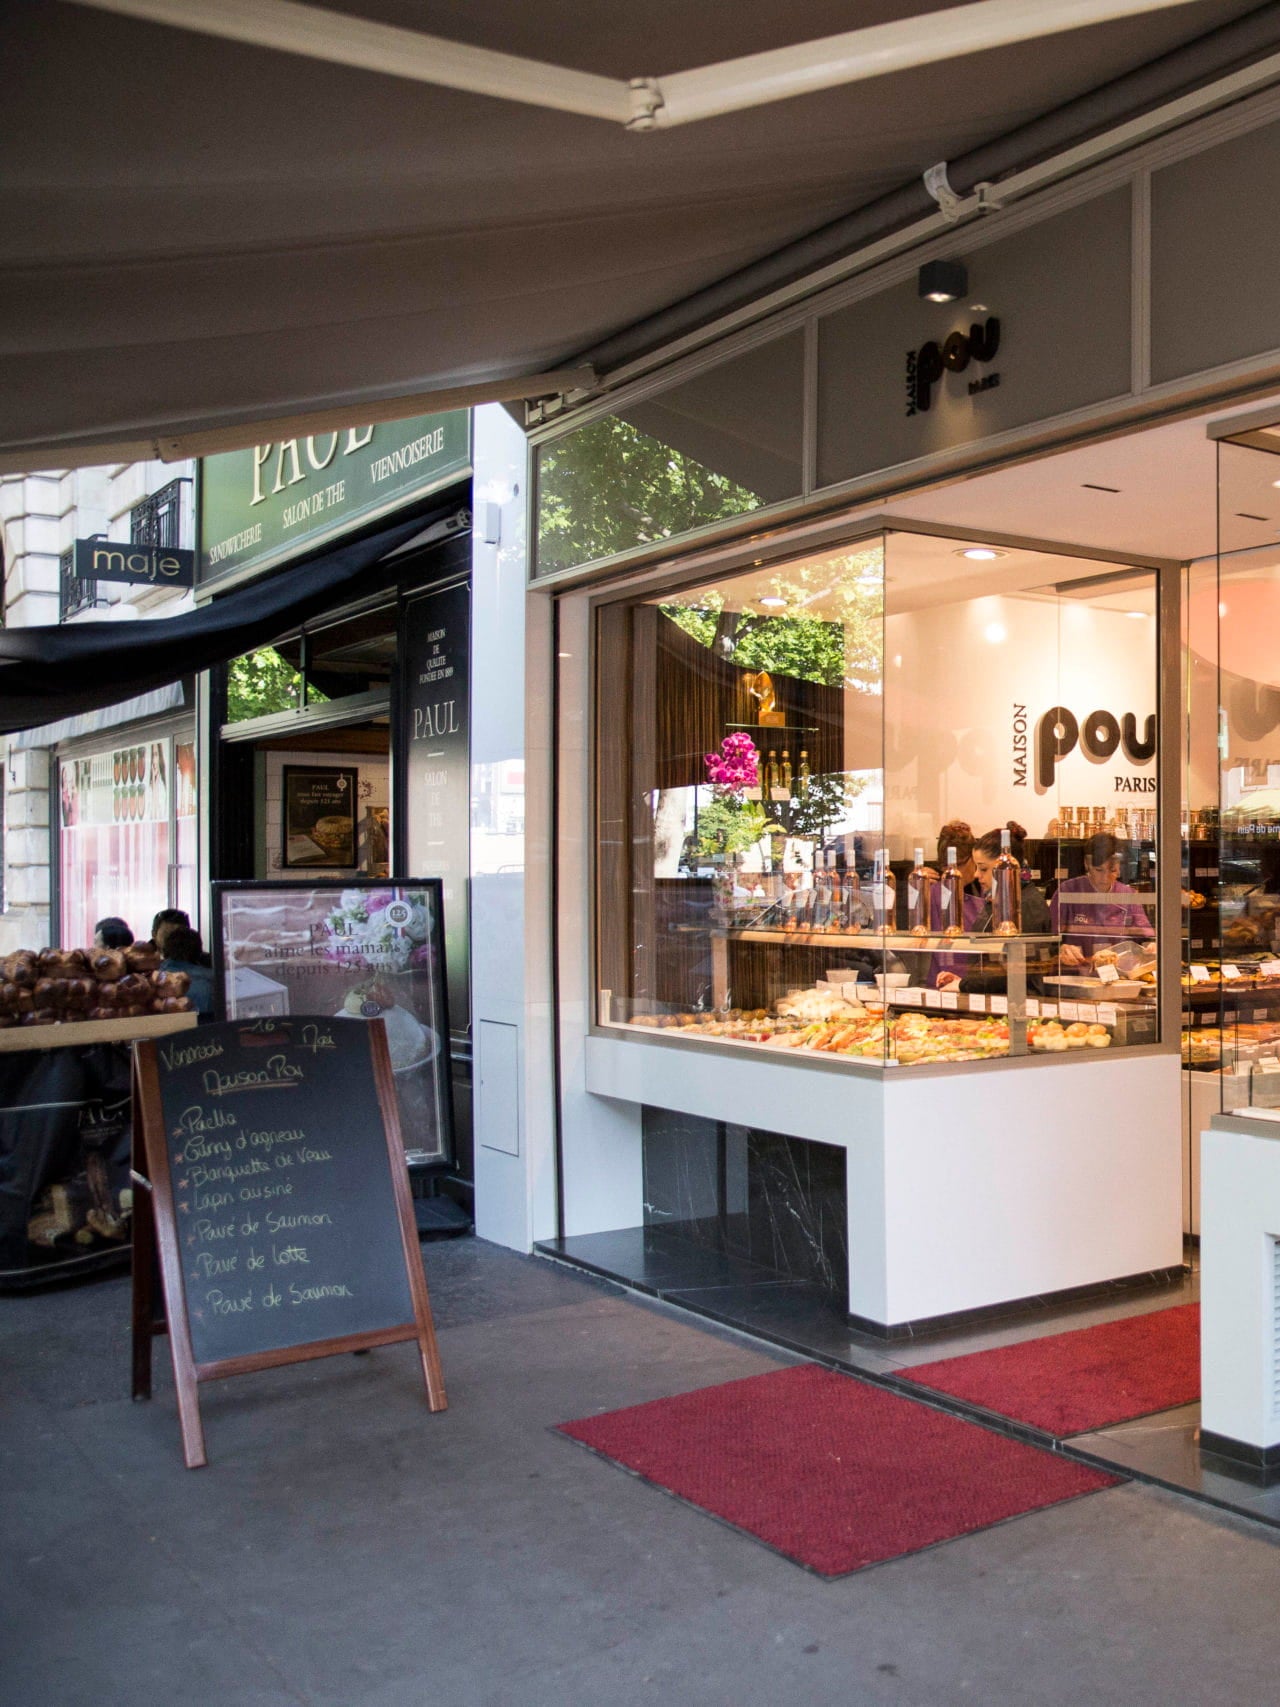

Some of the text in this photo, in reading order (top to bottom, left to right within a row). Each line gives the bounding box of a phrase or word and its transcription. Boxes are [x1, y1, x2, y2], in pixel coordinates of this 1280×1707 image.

[917, 316, 1001, 412] pou
[370, 426, 444, 484] VIENNOISERIE
[283, 480, 345, 529] SALON DE THE
[209, 523, 263, 566] SANDWICHERIE
[92, 549, 181, 581] maje
[413, 700, 460, 741] PAUL
[1012, 703, 1027, 788] MAISON
[1034, 705, 1156, 790] pou
[424, 770, 448, 786] SALON
[1114, 775, 1156, 793] PARIS
[309, 922, 360, 938] PAUL
[264, 945, 304, 959] aime
[310, 941, 331, 955] les
[274, 964, 329, 979] depuis
[333, 959, 362, 973] 125
[180, 1106, 237, 1134] Paella
[241, 1210, 260, 1236] de
[265, 1211, 333, 1234] Saumon
[247, 1247, 266, 1272] de
[263, 1283, 283, 1307] de
[289, 1283, 354, 1305] Saumon
